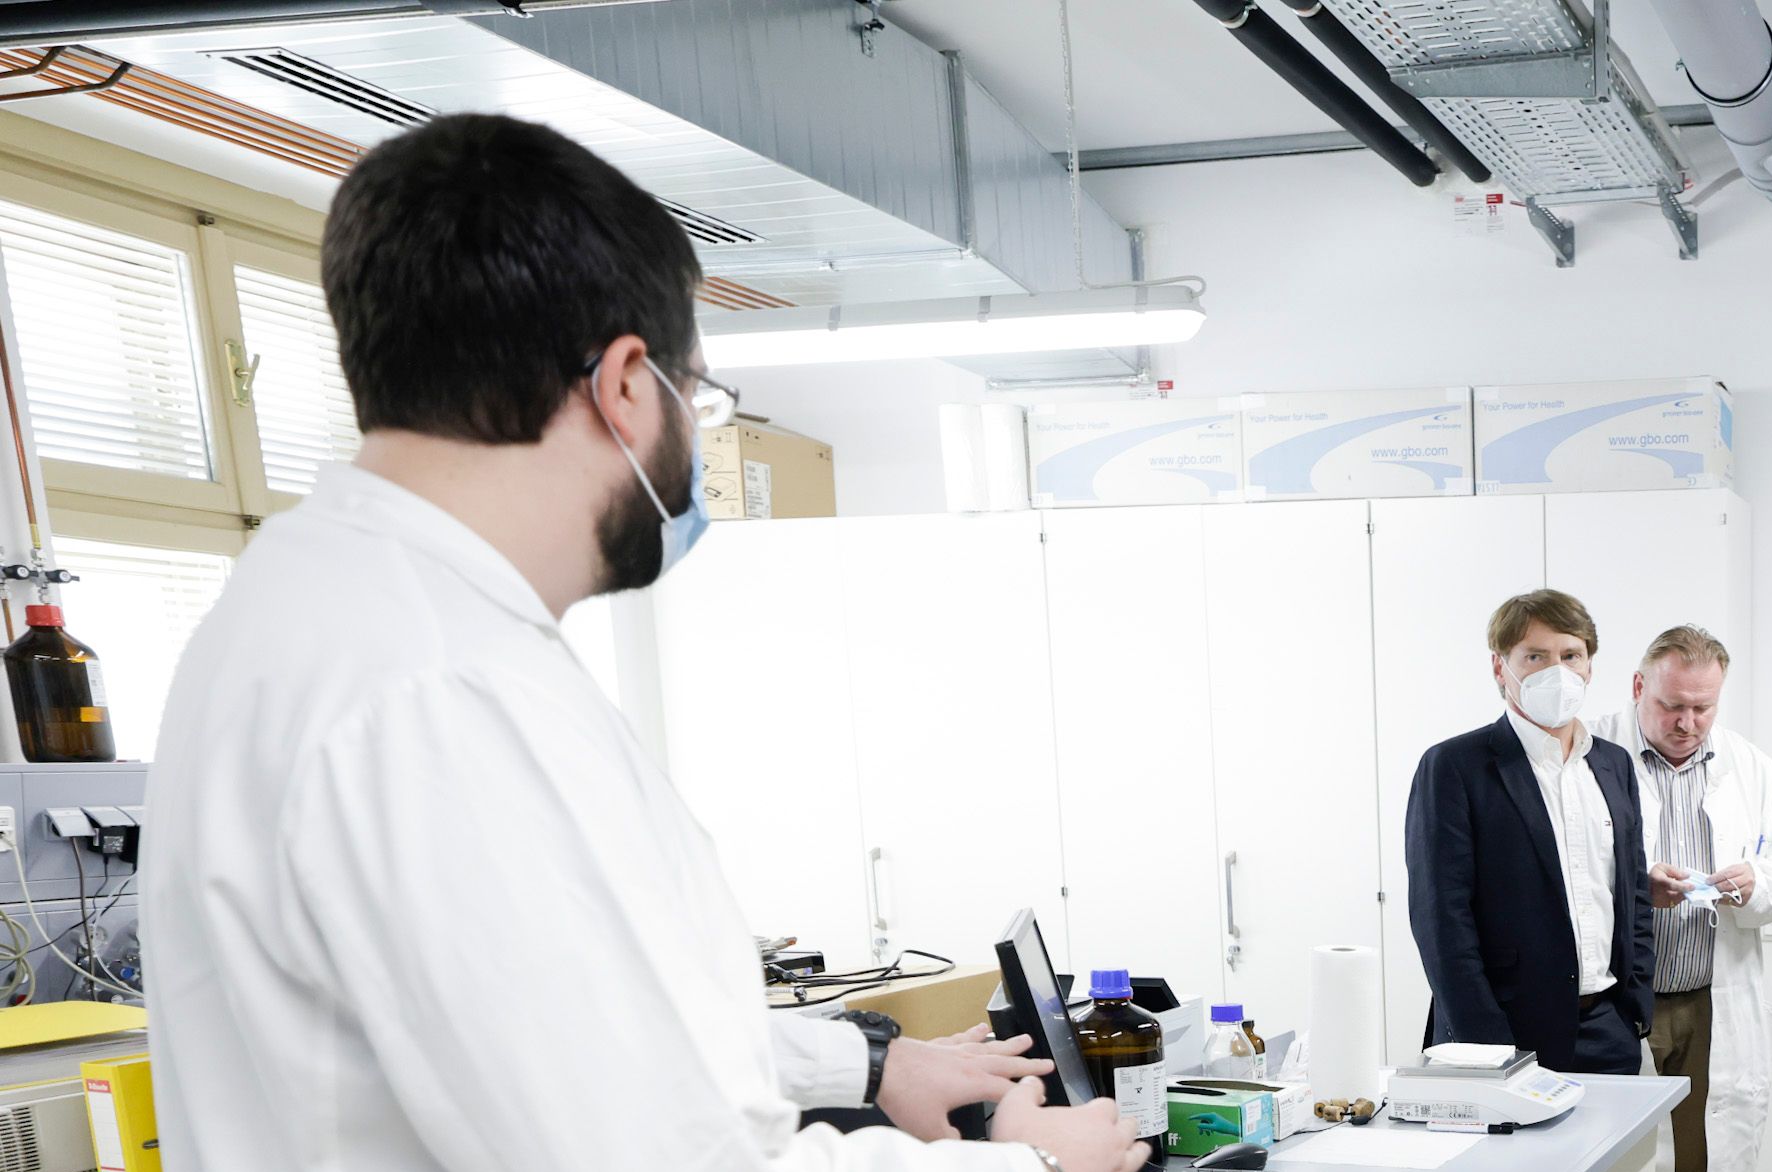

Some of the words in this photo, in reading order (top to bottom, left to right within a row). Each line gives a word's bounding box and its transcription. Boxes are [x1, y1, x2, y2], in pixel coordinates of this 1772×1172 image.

[1483, 402, 1500, 412] Your
[1502, 401, 1526, 411] Power
[1527, 400, 1538, 409] for
[1540, 399, 1565, 409] Health
[1250, 414, 1267, 423] Your
[1269, 413, 1292, 422] Power
[1293, 413, 1303, 421] for
[1305, 412, 1328, 421] Health
[1608, 432, 1689, 447] www.gbo.com
[1371, 446, 1448, 459] www.gbo.com
[1150, 453, 1222, 467] www.gbo.com
